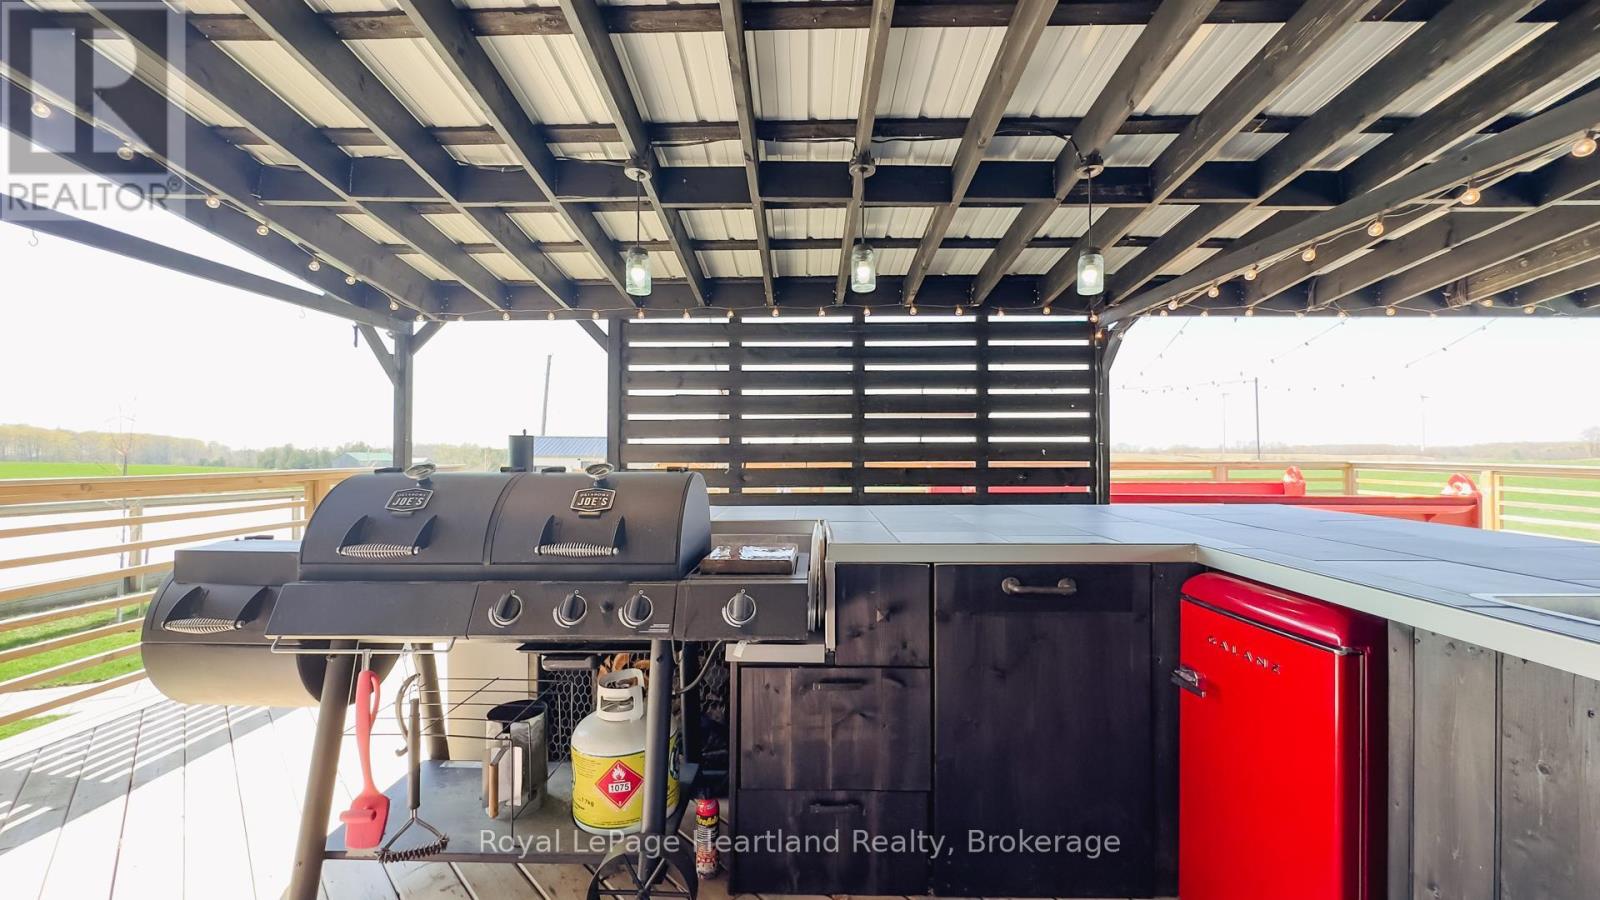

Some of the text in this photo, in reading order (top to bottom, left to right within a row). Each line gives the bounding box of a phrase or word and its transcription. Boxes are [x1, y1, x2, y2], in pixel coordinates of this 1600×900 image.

[391, 497, 425, 506] JOE'S
[577, 497, 608, 506] JOE'S
[610, 783, 630, 793] 1075
